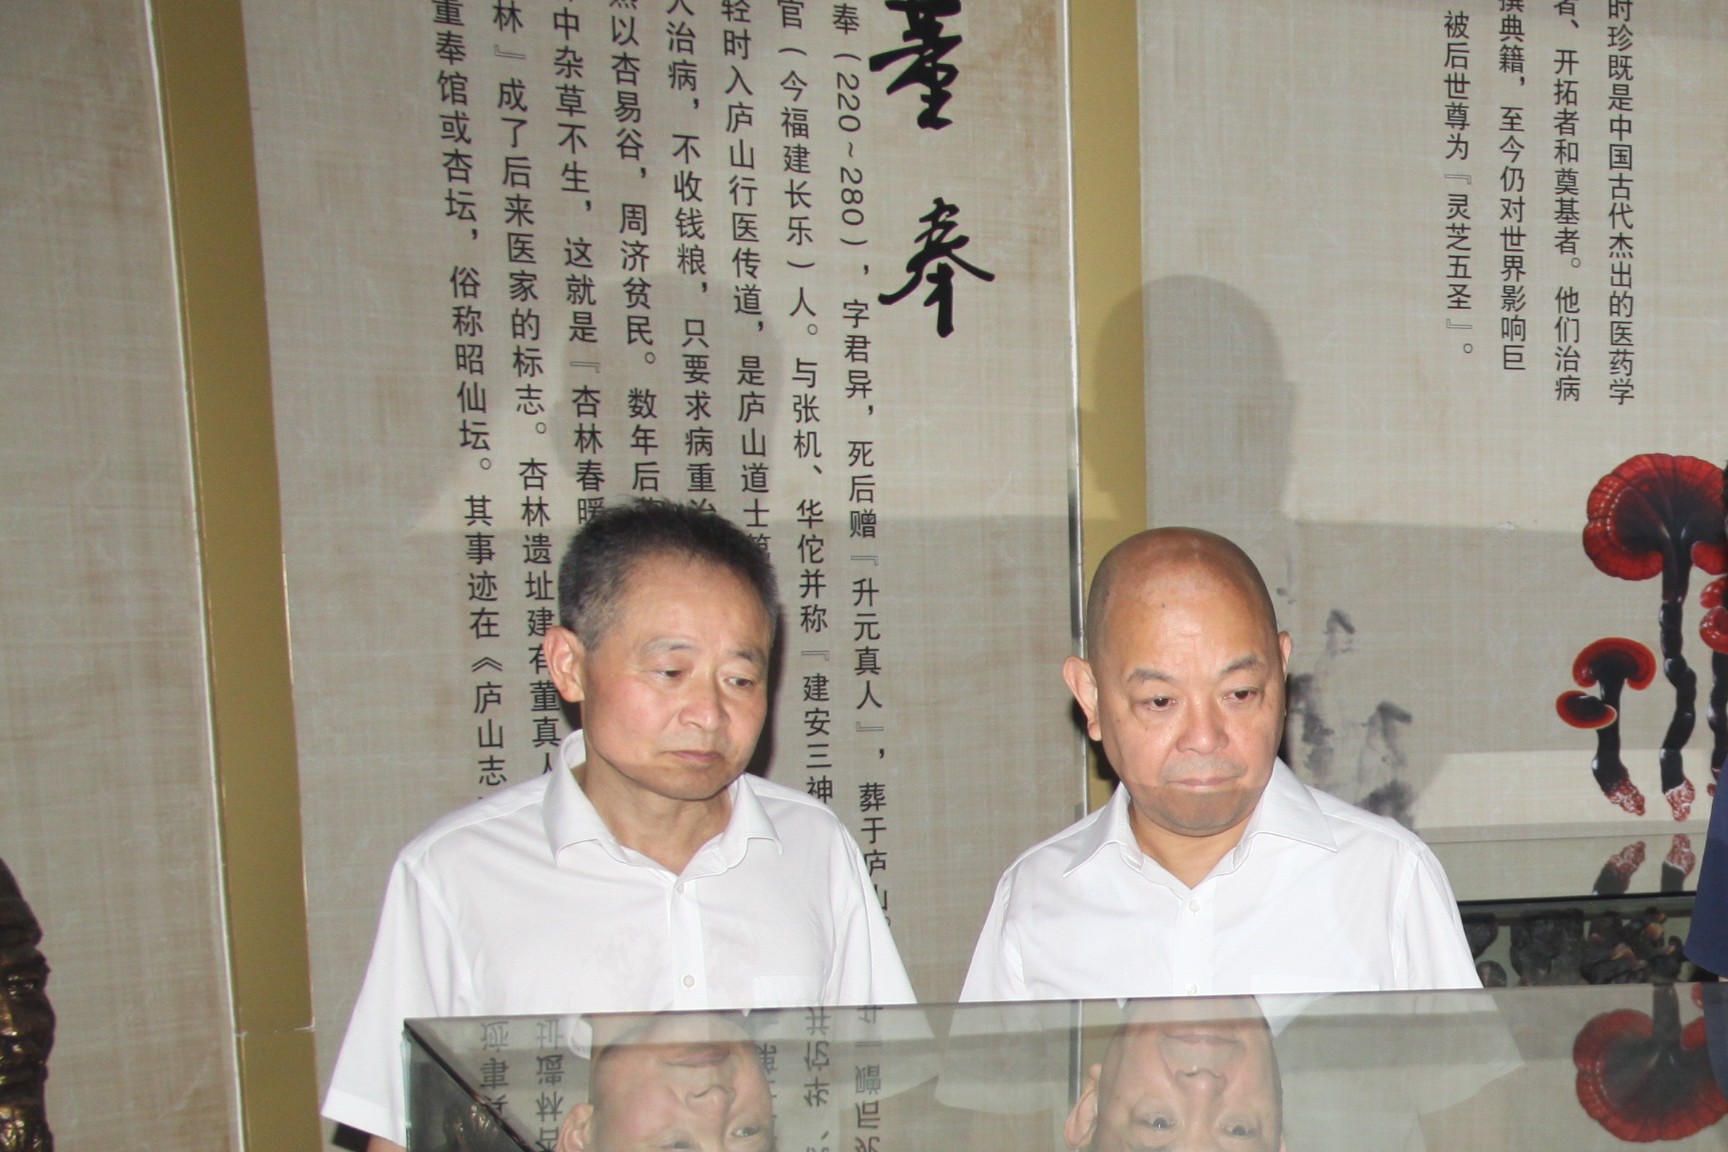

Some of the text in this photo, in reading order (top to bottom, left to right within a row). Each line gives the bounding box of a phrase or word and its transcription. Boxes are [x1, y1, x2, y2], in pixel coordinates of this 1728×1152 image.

[609, 0, 665, 503] 以杏易谷，周济贫民。数年后
